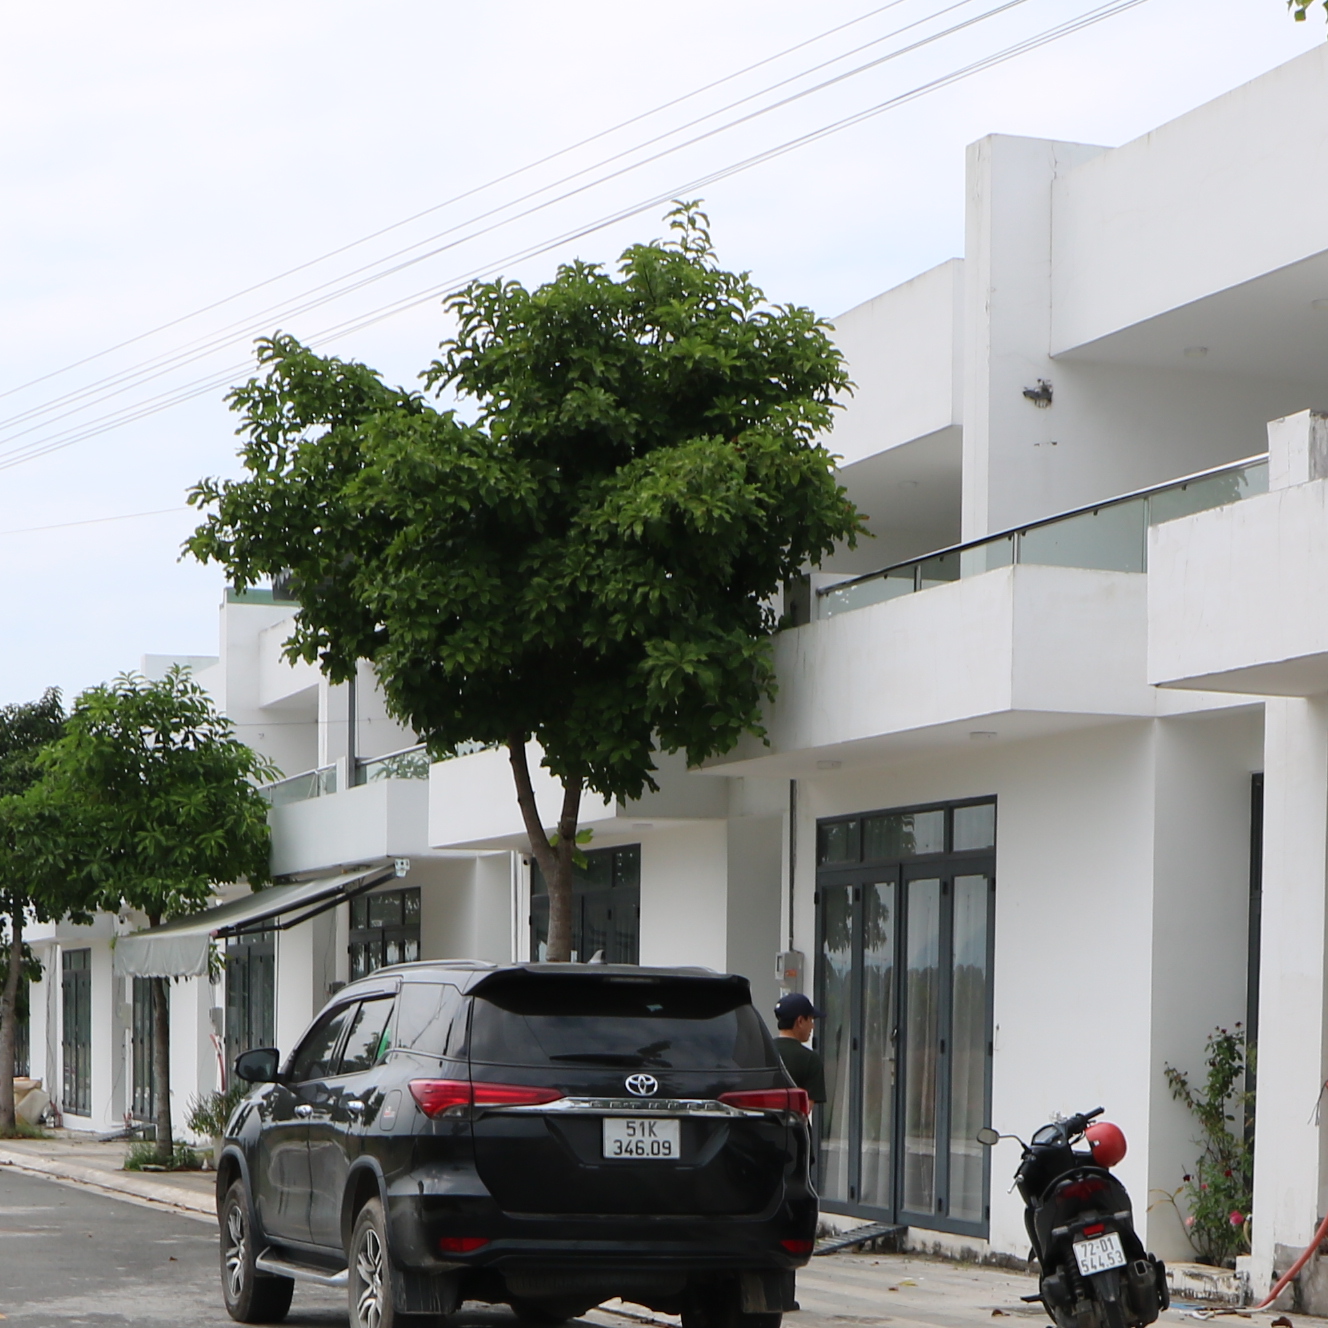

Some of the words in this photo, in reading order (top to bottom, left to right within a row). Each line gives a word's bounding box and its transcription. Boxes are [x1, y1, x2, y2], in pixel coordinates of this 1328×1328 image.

[626, 1120, 658, 1137] 51K
[613, 1139, 672, 1156] 346.09
[1081, 1250, 1123, 1272] 544.53
